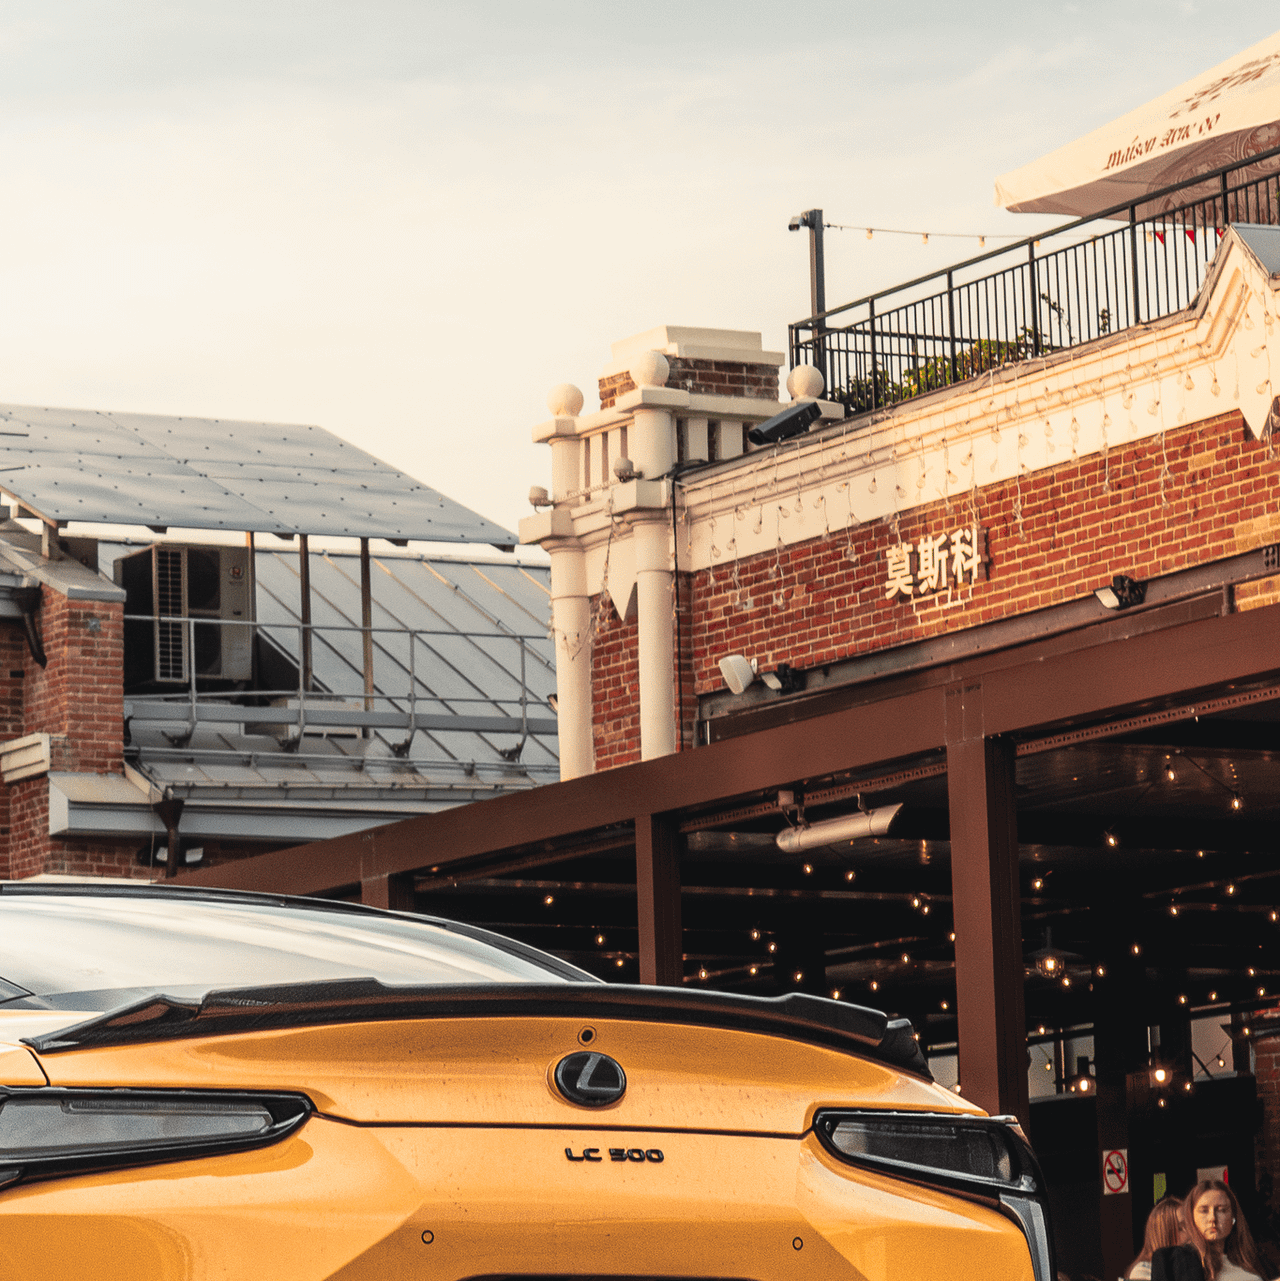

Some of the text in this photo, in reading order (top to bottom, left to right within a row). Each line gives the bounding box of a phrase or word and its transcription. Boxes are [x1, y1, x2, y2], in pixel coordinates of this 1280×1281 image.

[885, 528, 982, 600] 莫斯科
[564, 1147, 665, 1163] LC 500
